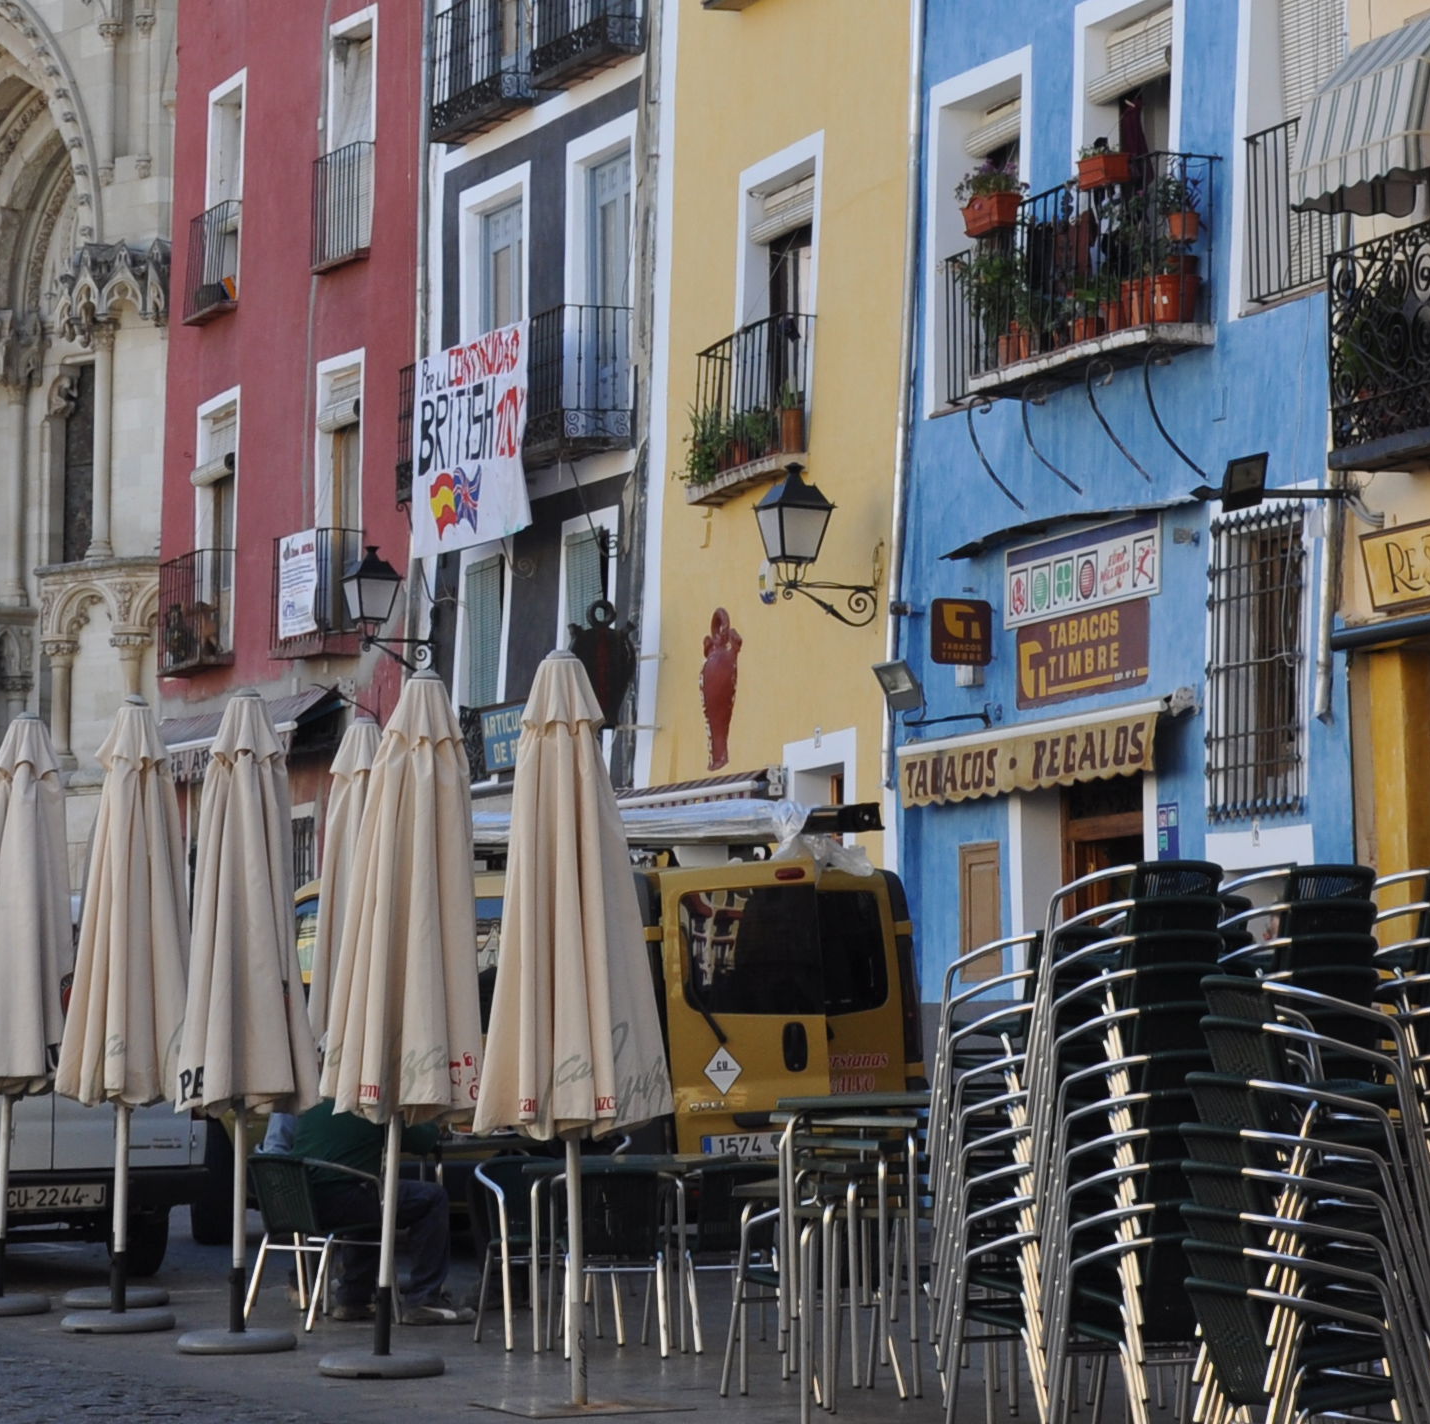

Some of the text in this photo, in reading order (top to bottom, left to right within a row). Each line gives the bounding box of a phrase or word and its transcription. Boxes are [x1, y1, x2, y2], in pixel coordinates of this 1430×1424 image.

[419, 377, 495, 476] BRITISH
[1049, 609, 1119, 649] TABACOS
[942, 642, 981, 651] TABACOS
[942, 652, 981, 661] TIMBRE
[1049, 642, 1119, 681] TIMBRE
[484, 709, 522, 738] ARTICUL
[493, 741, 508, 764] DE
[905, 722, 1145, 798] TABACOS REGALOS
[716, 1060, 728, 1070] CU
[719, 1136, 762, 1155] 1574
